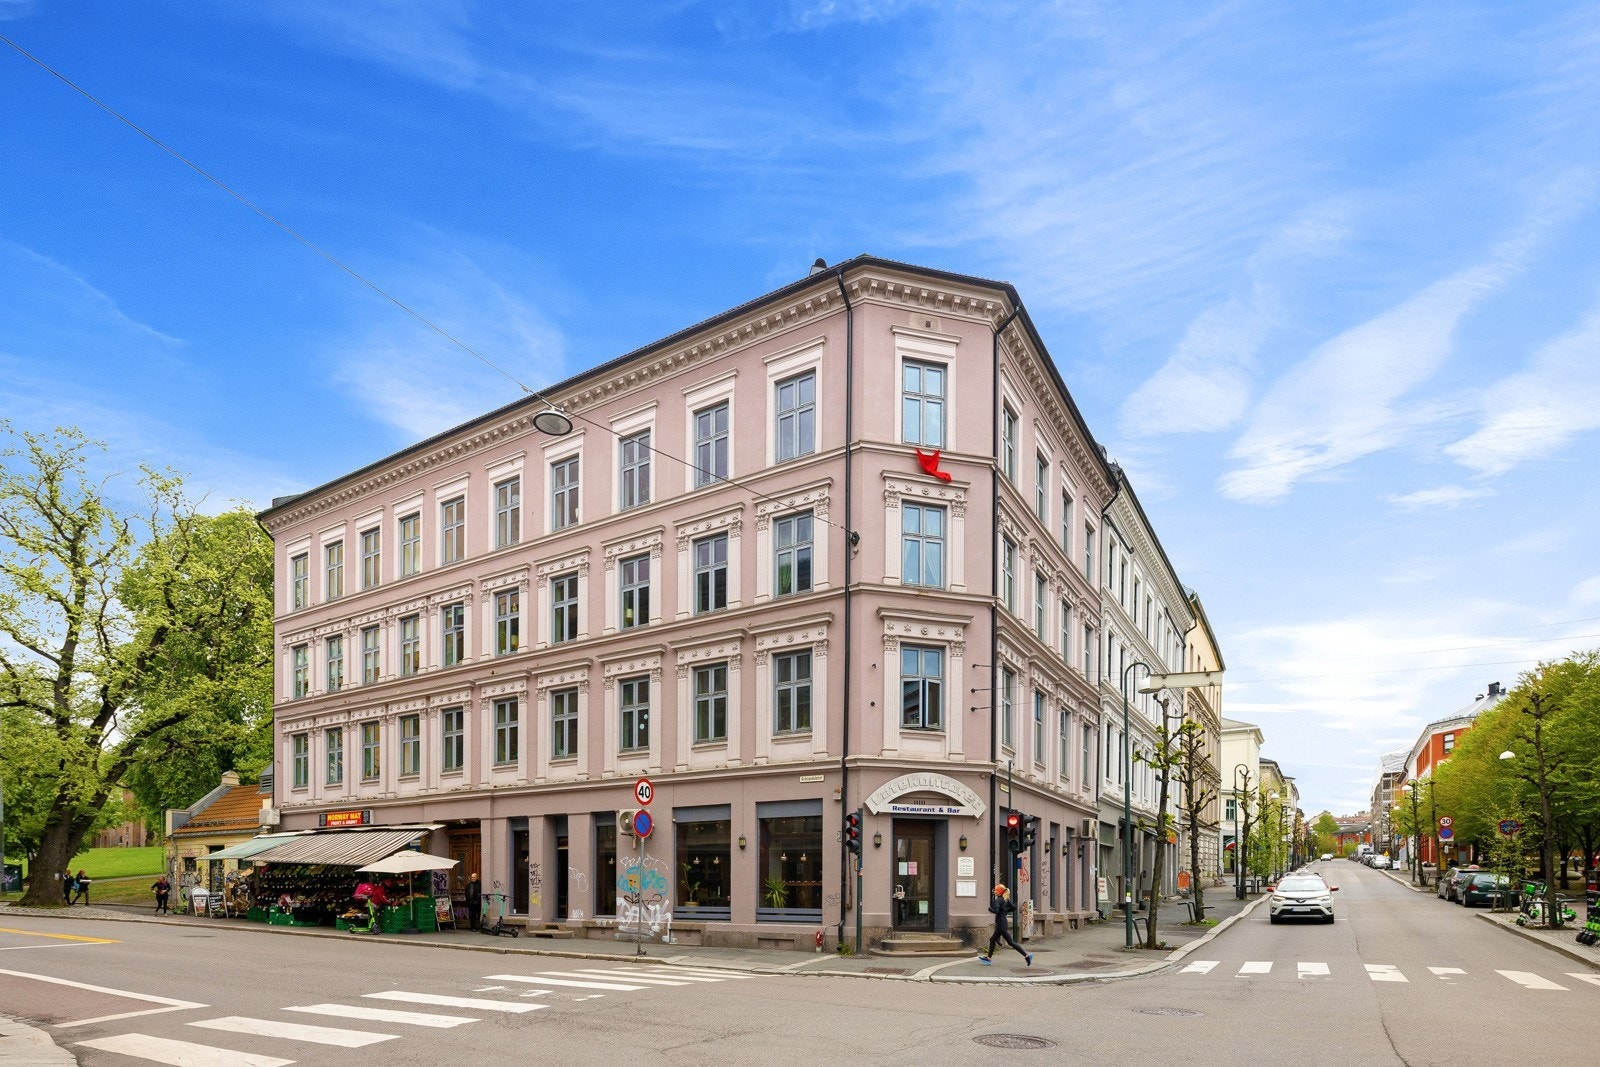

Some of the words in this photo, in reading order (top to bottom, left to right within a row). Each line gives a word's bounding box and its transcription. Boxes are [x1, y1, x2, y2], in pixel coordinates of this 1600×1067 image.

[638, 785, 651, 799] 40
[892, 805, 935, 813] Restaurant
[327, 813, 349, 821] NORWAY
